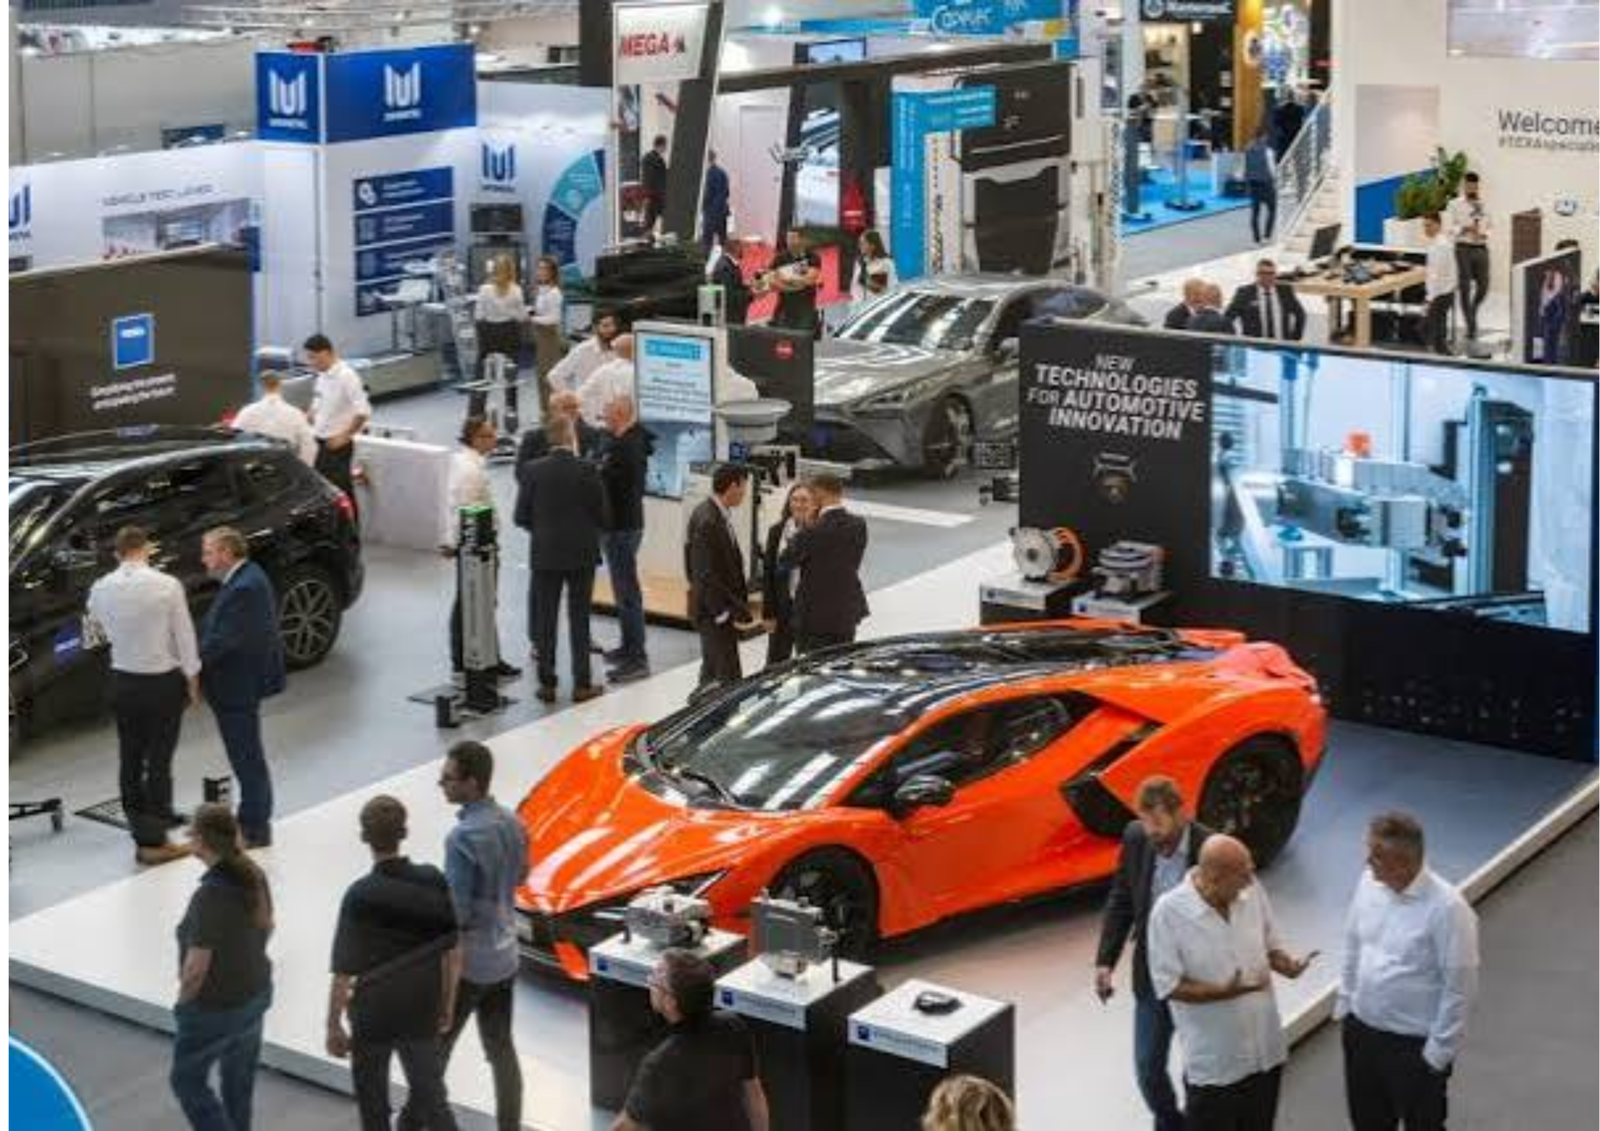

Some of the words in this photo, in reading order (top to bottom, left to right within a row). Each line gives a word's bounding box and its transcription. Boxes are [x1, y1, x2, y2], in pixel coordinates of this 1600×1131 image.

[621, 32, 670, 56] MEGA
[1095, 354, 1135, 371] NEW
[1035, 363, 1198, 399] TECHNOLOGIES
[1028, 387, 1060, 405] FOR
[1062, 389, 1206, 422] AUTOMOTIVE
[1049, 407, 1183, 440] INNOVATION
